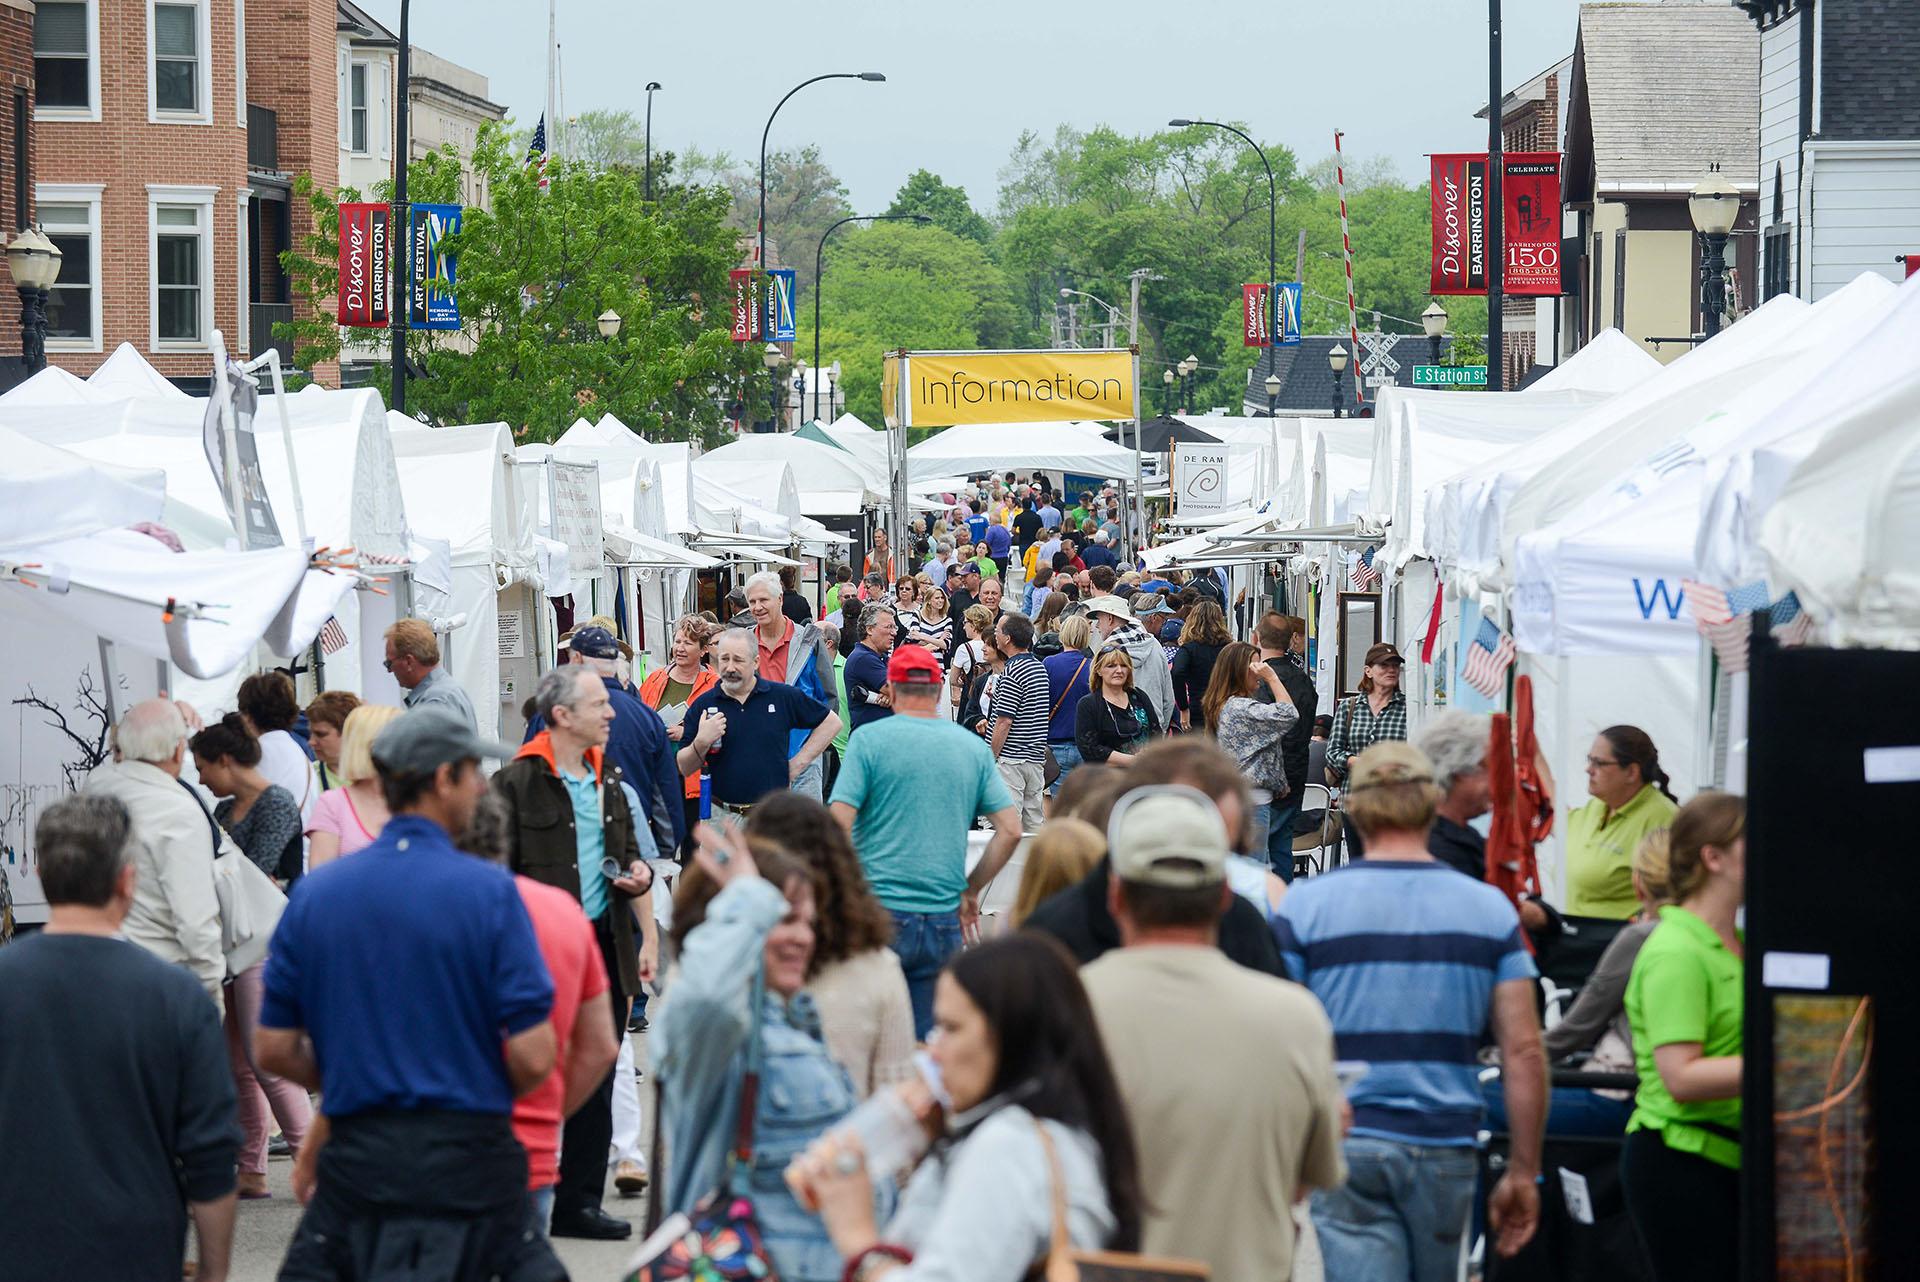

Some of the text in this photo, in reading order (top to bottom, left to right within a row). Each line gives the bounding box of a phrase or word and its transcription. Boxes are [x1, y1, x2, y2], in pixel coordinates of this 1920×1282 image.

[1441, 176, 1460, 276] Discover
[1471, 176, 1483, 275] BARRINGTON
[347, 223, 364, 311] Discover
[374, 223, 384, 311] BARRINGTON
[415, 223, 426, 310] ART FESTIVAL
[1508, 247, 1558, 267] 150
[1248, 293, 1257, 338] Discover
[1361, 335, 1399, 371] RAIL ROAD
[1377, 368, 1383, 377] 2
[922, 371, 1122, 409] Information
[1416, 368, 1484, 382] E Station St
[1184, 455, 1197, 463] DE
